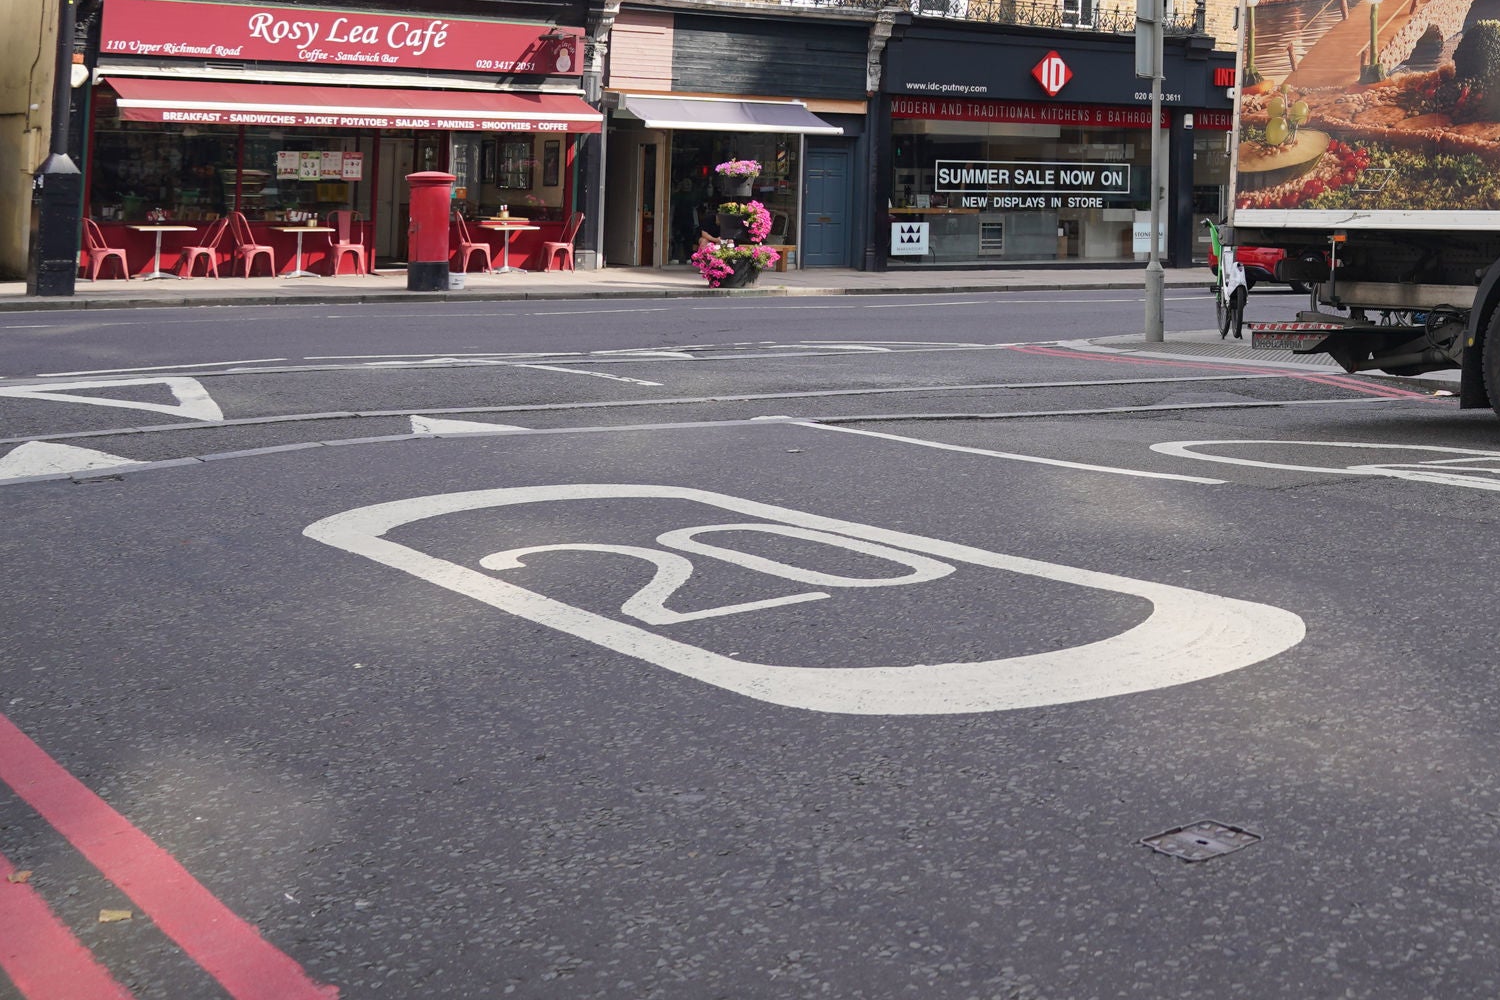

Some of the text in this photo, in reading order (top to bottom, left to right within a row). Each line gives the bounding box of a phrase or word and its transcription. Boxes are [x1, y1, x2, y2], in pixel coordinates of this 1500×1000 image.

[248, 12, 450, 56] Rosy Lea Café
[106, 40, 243, 56] 110 Upper Richmond Road
[299, 50, 328, 62] Coffee
[334, 51, 379, 62] Sandwich
[380, 54, 400, 64] Bar
[476, 60, 536, 70] 020 3417 2051
[1042, 57, 1066, 92] ID
[906, 81, 987, 93] www.idc-putney.com
[1134, 92, 1180, 101] 020 80 3611
[162, 112, 221, 122] BREAKFAST
[230, 114, 296, 124] SANDWICHES
[304, 116, 338, 125] JACKET
[340, 116, 388, 126] POTATOES
[396, 118, 430, 128] SALADS
[437, 120, 474, 129] PANINIS
[482, 120, 530, 130] SMOOTHIES
[538, 122, 568, 130] COFFEE
[890, 102, 1166, 124] MODERN AND TRADITIONAL KITCHENS & BATHROOS
[938, 168, 1122, 186] SUMMER SALE NOW ON
[962, 196, 1103, 208] NEW DISPLAYS IN STORE
[478, 522, 958, 627] 20
